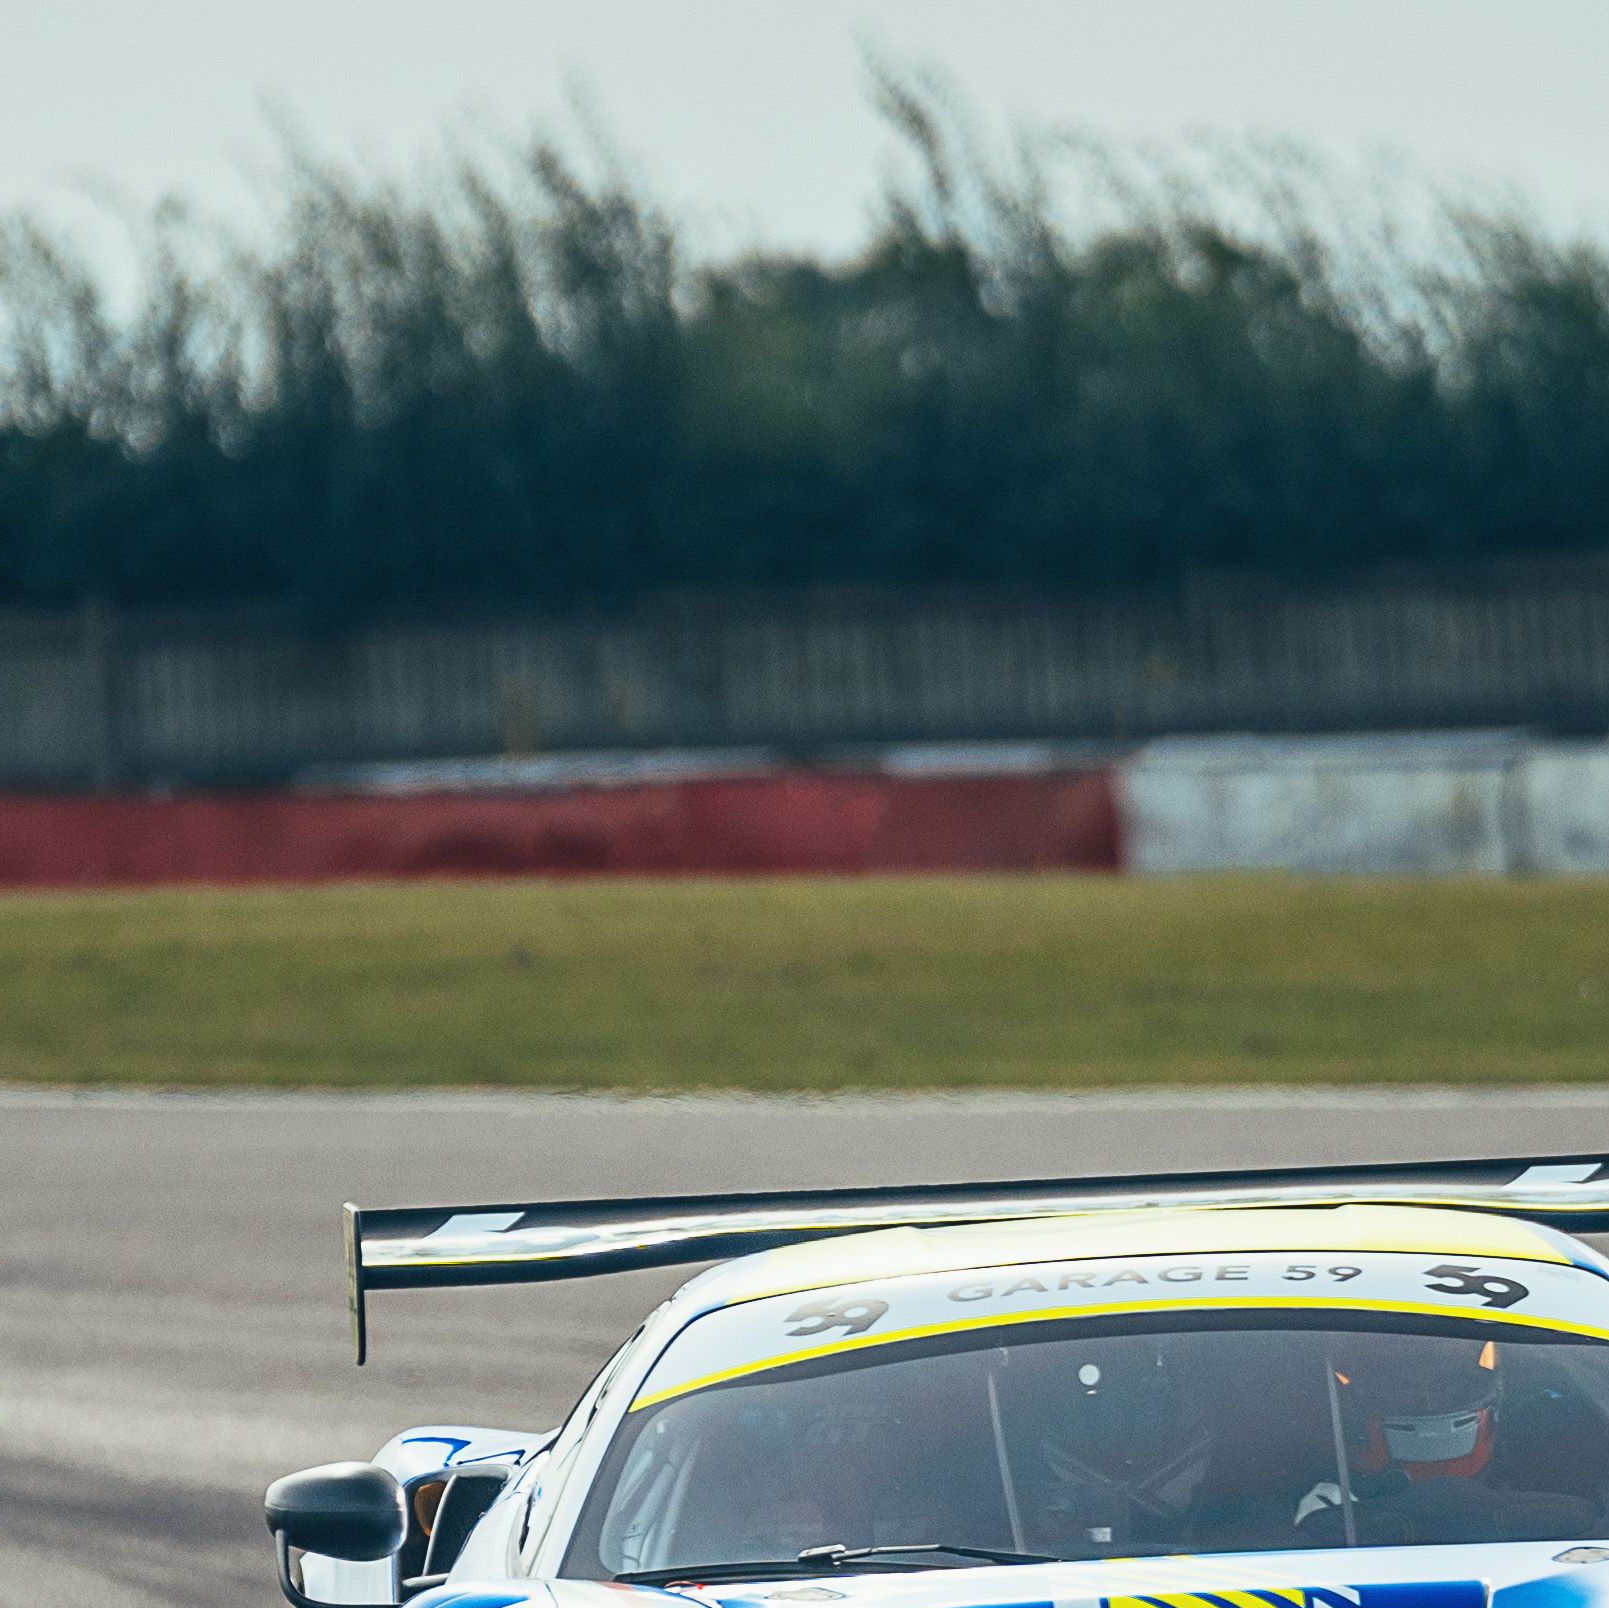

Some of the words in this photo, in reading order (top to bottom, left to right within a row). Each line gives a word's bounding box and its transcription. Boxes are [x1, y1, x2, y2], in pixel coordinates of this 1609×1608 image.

[946, 1264, 1250, 1303] GARAGE
[1280, 1264, 1364, 1283] 59
[1422, 1263, 1530, 1310] 59
[782, 1296, 890, 1337] 59
